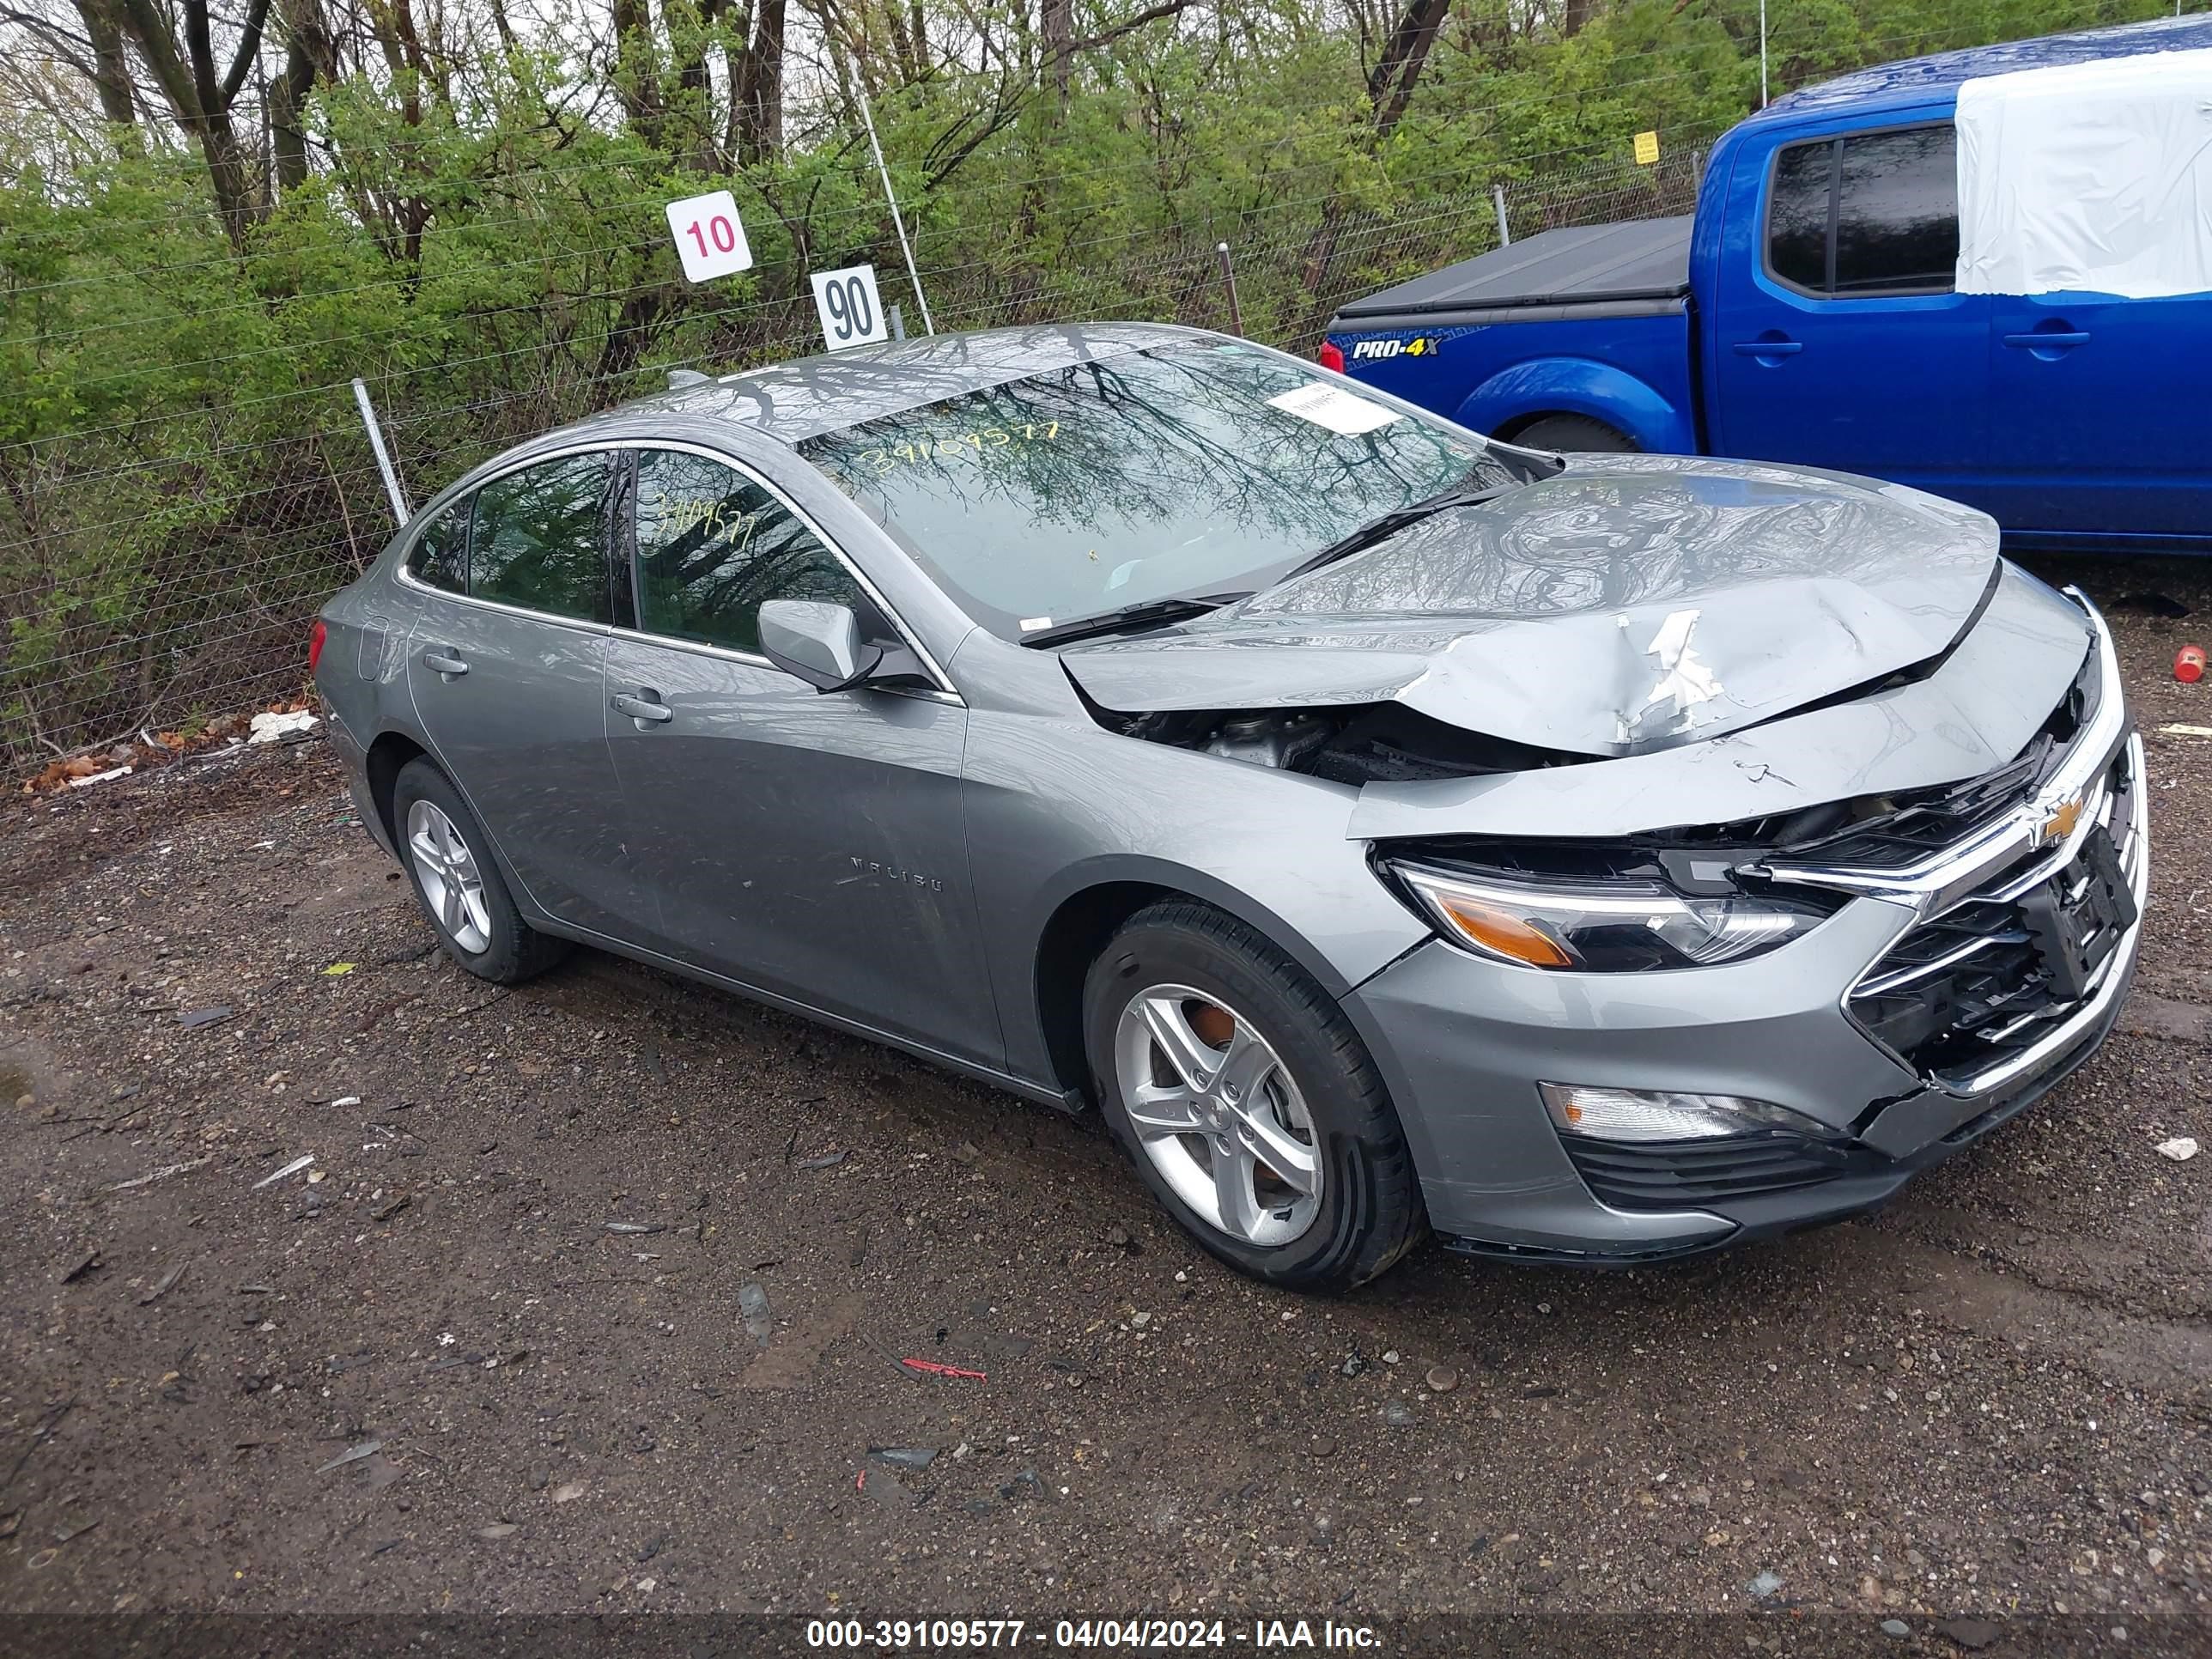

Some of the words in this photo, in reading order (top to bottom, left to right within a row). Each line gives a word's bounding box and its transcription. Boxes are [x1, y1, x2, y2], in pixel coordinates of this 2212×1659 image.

[686, 215, 736, 258] 10
[825, 276, 872, 341] 90
[1352, 337, 1443, 359] PRO-4X
[860, 421, 1058, 474] 39109577
[850, 857, 943, 892] MALIBU
